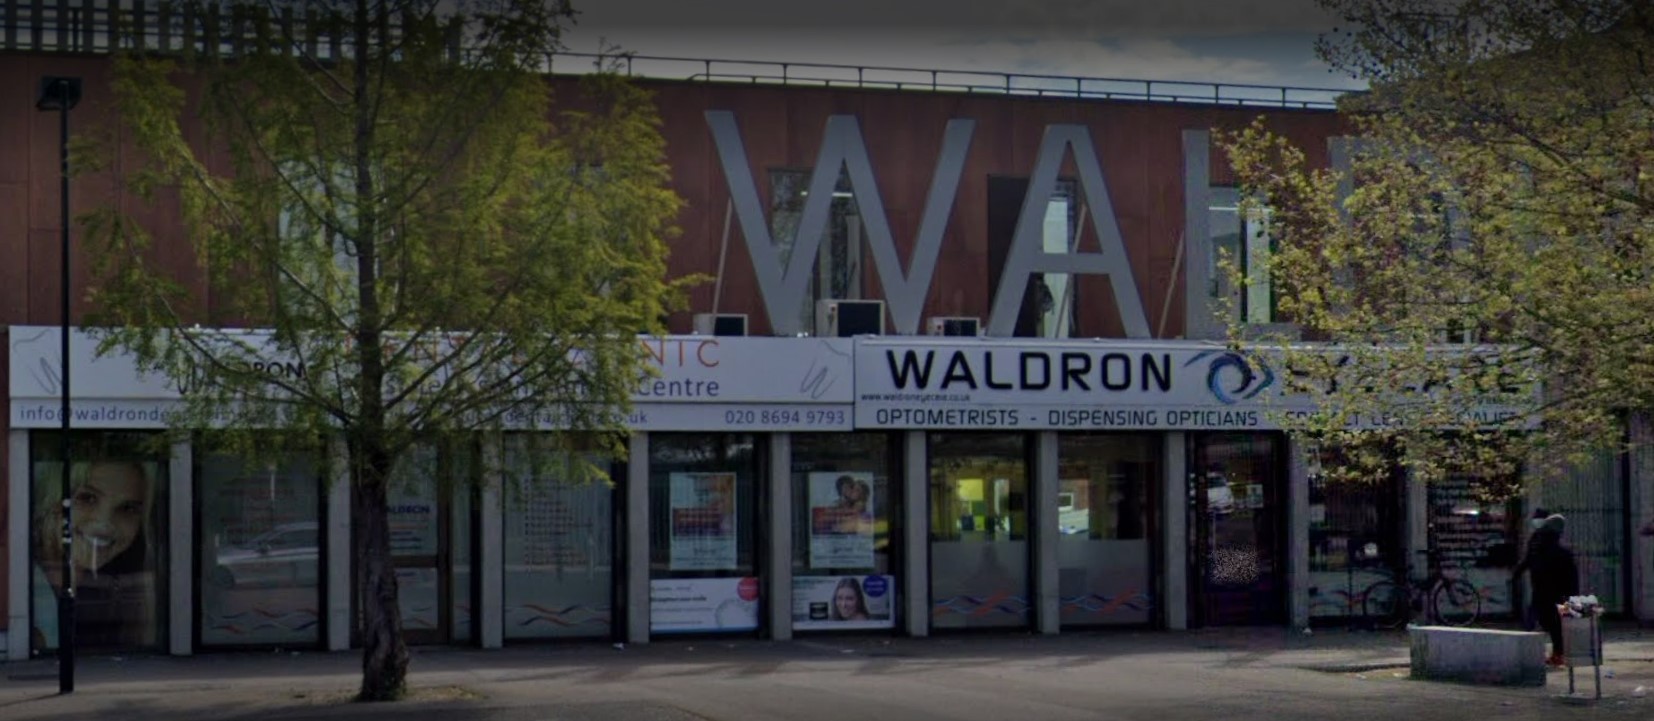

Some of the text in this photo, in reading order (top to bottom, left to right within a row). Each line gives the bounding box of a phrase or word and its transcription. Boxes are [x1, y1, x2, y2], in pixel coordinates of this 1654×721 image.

[886, 350, 1172, 392] WALDRON
[725, 411, 846, 425] 020 8694 9793
[876, 409, 1018, 426] OPTOMETRISTS
[1049, 410, 1157, 426] DISPENSING
[1167, 410, 1258, 427] OPTICIANS
